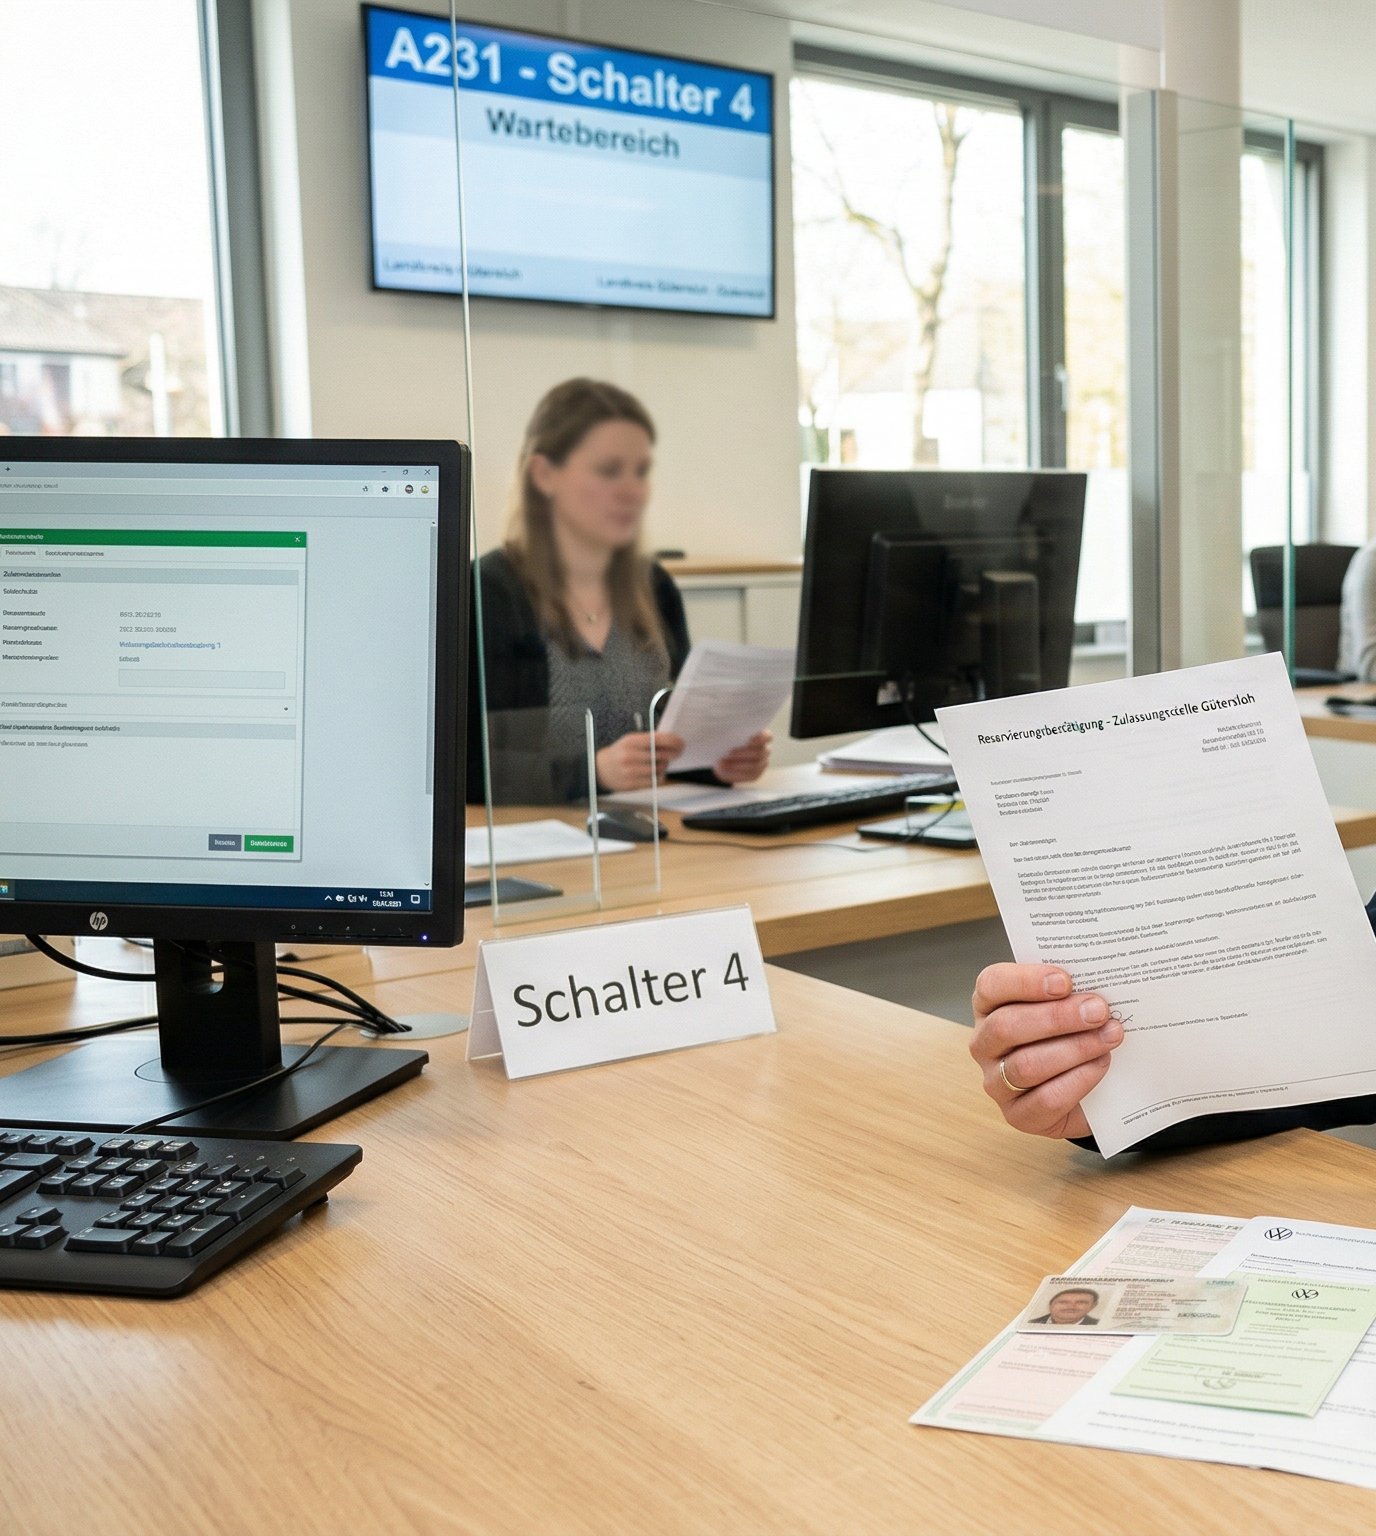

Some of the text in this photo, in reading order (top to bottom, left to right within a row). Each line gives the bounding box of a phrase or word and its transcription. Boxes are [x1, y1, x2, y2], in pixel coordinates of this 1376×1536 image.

[386, 26, 501, 83] A231
[546, 51, 721, 116] Schalter
[729, 83, 756, 122] 4
[486, 107, 682, 158] Wartebereich
[90, 911, 108, 930] hp
[512, 952, 749, 1028] Schalter 4
